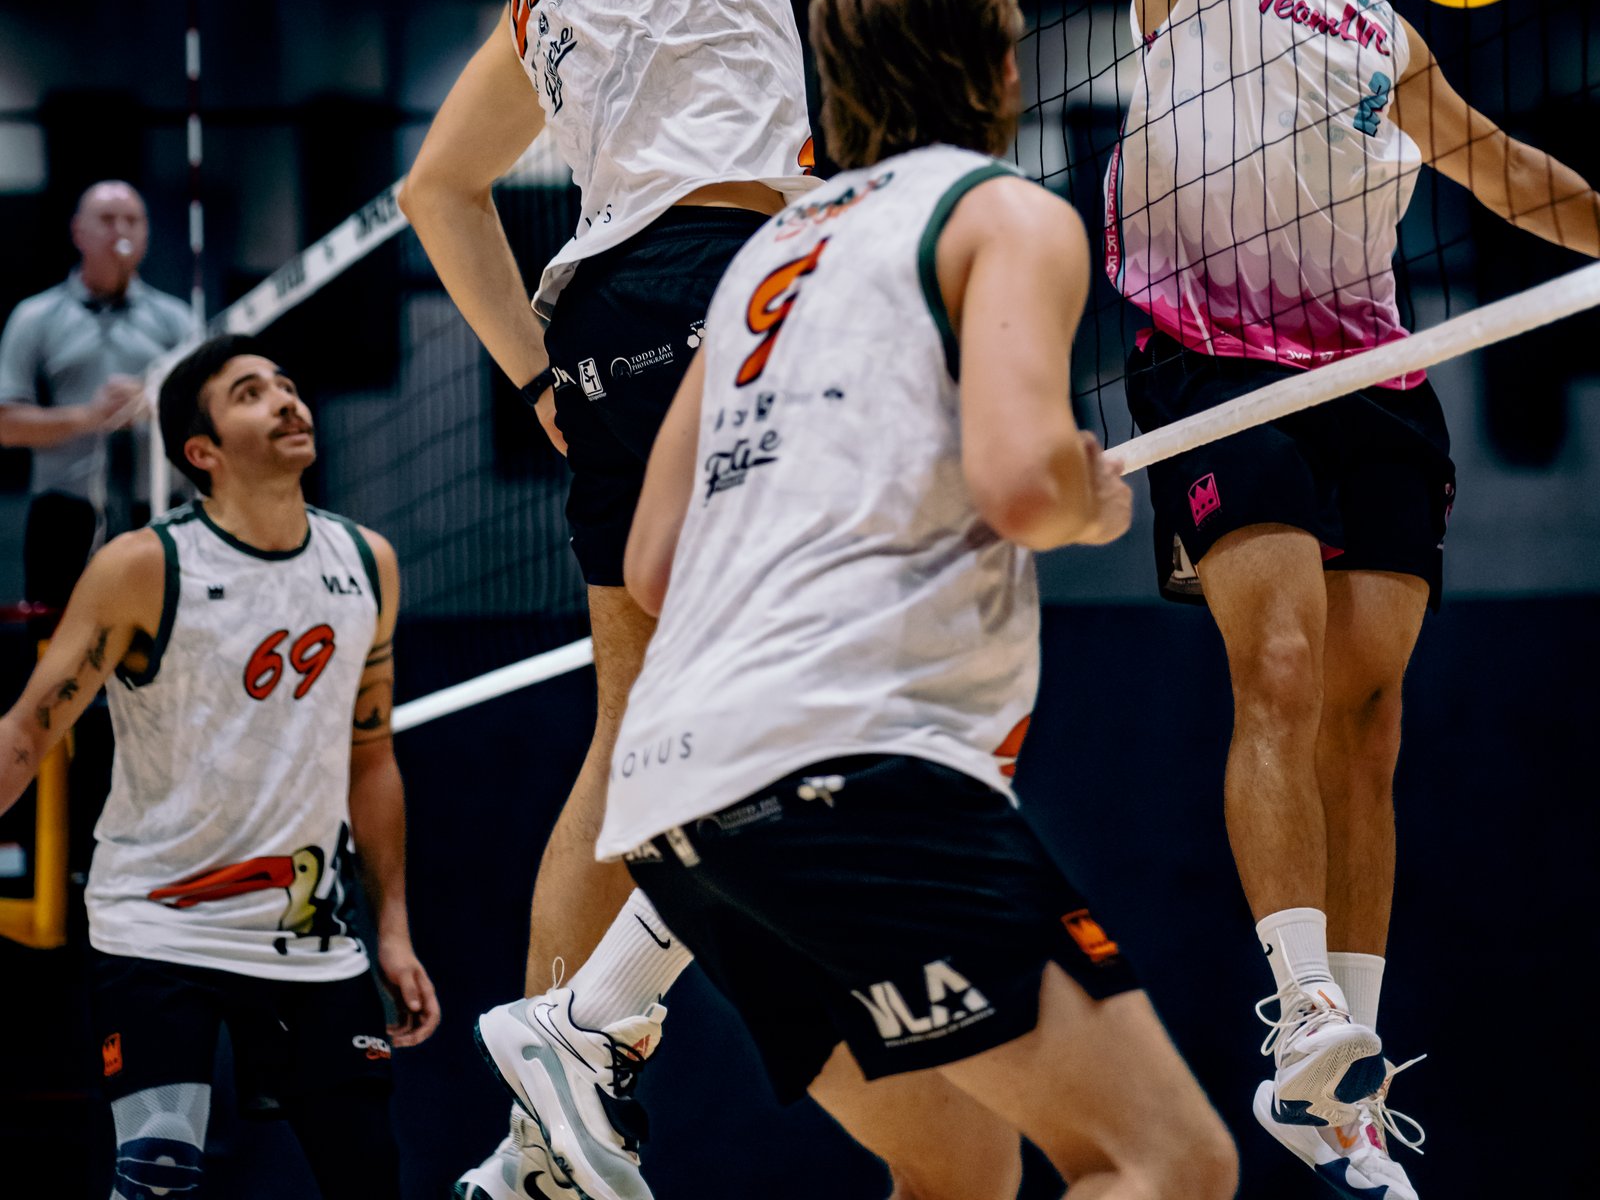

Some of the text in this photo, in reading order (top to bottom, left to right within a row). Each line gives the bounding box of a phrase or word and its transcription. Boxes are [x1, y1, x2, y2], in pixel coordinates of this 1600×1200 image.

[734, 234, 833, 388] 9
[631, 343, 671, 364] TODD JAY
[632, 351, 674, 371] PHOTOGRAPHY
[322, 574, 362, 596] VLA
[243, 623, 335, 701] 69
[609, 731, 694, 783] OVUS
[850, 959, 989, 1040] VLA
